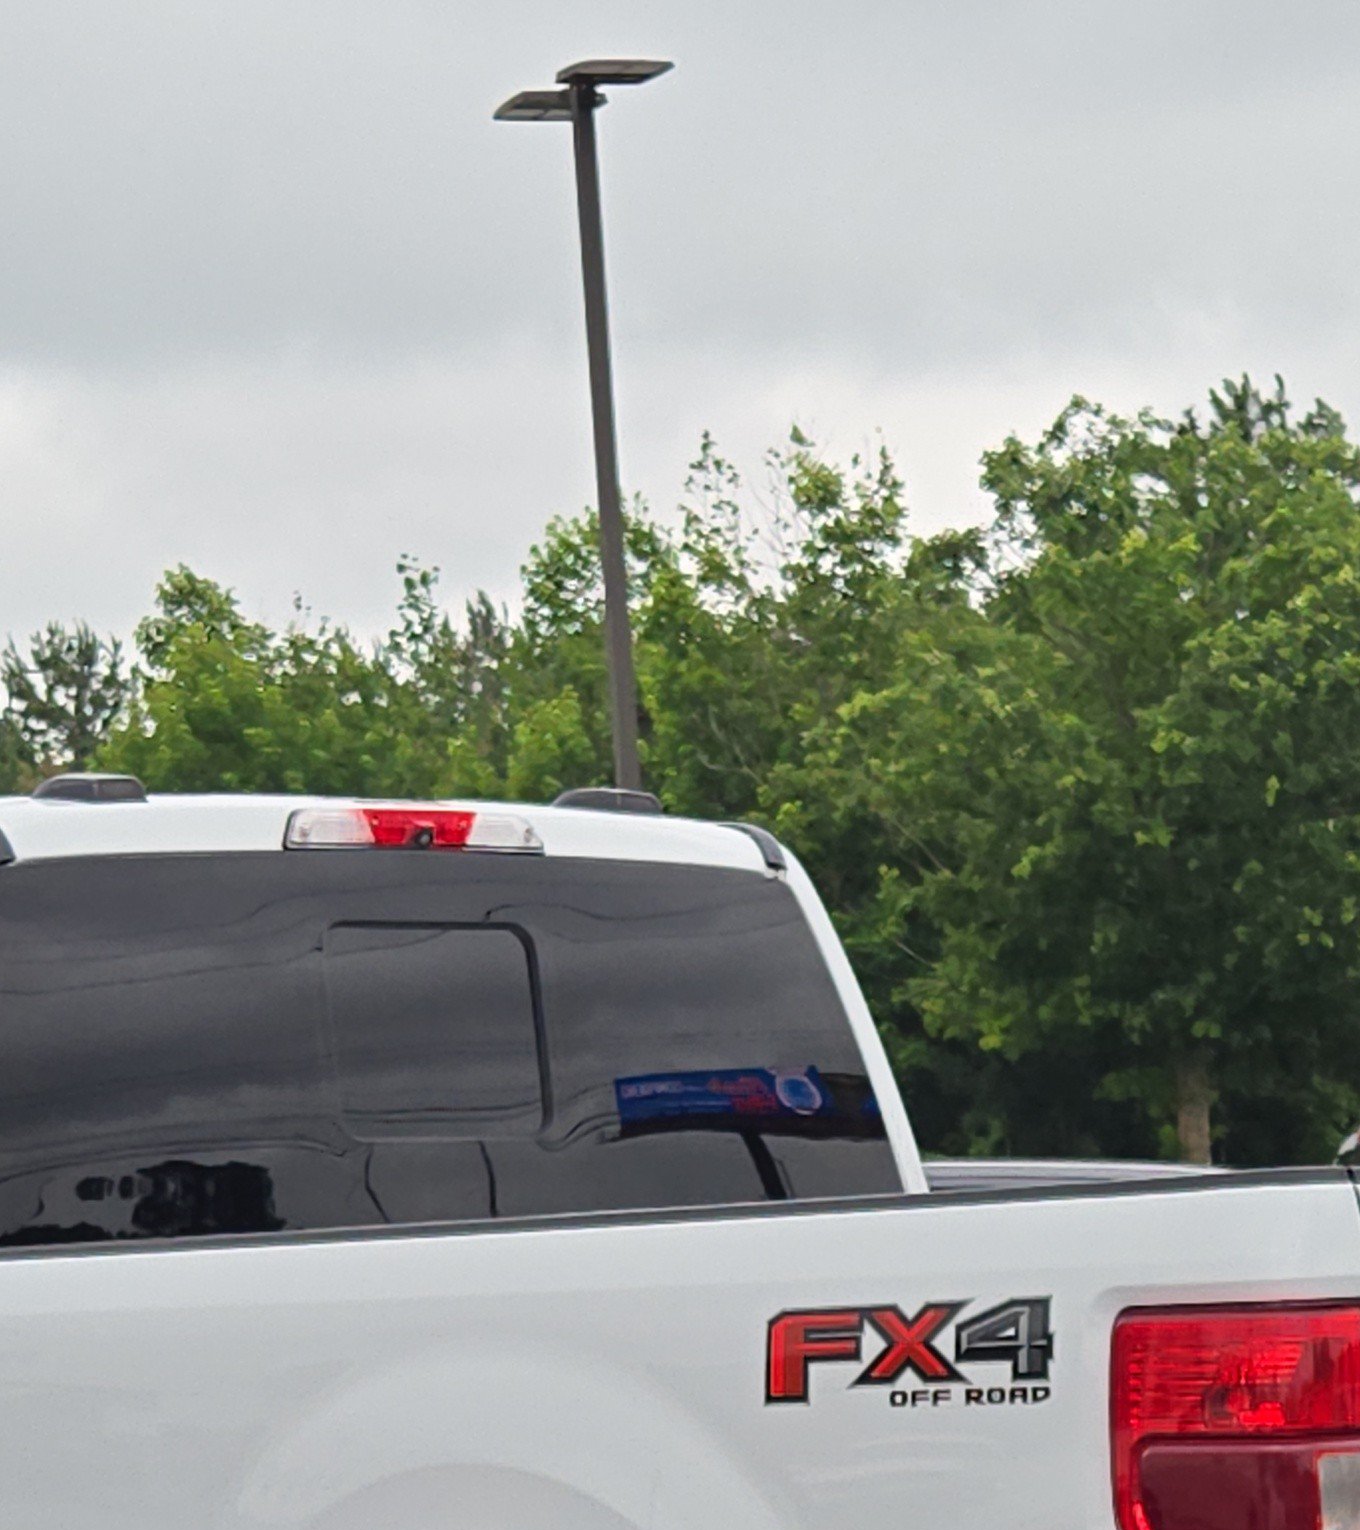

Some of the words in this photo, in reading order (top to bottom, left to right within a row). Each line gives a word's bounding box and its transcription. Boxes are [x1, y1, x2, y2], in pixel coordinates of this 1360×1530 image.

[765, 1295, 1054, 1405] FX4
[889, 1389, 952, 1407] OFF
[965, 1386, 1051, 1406] ROAD
